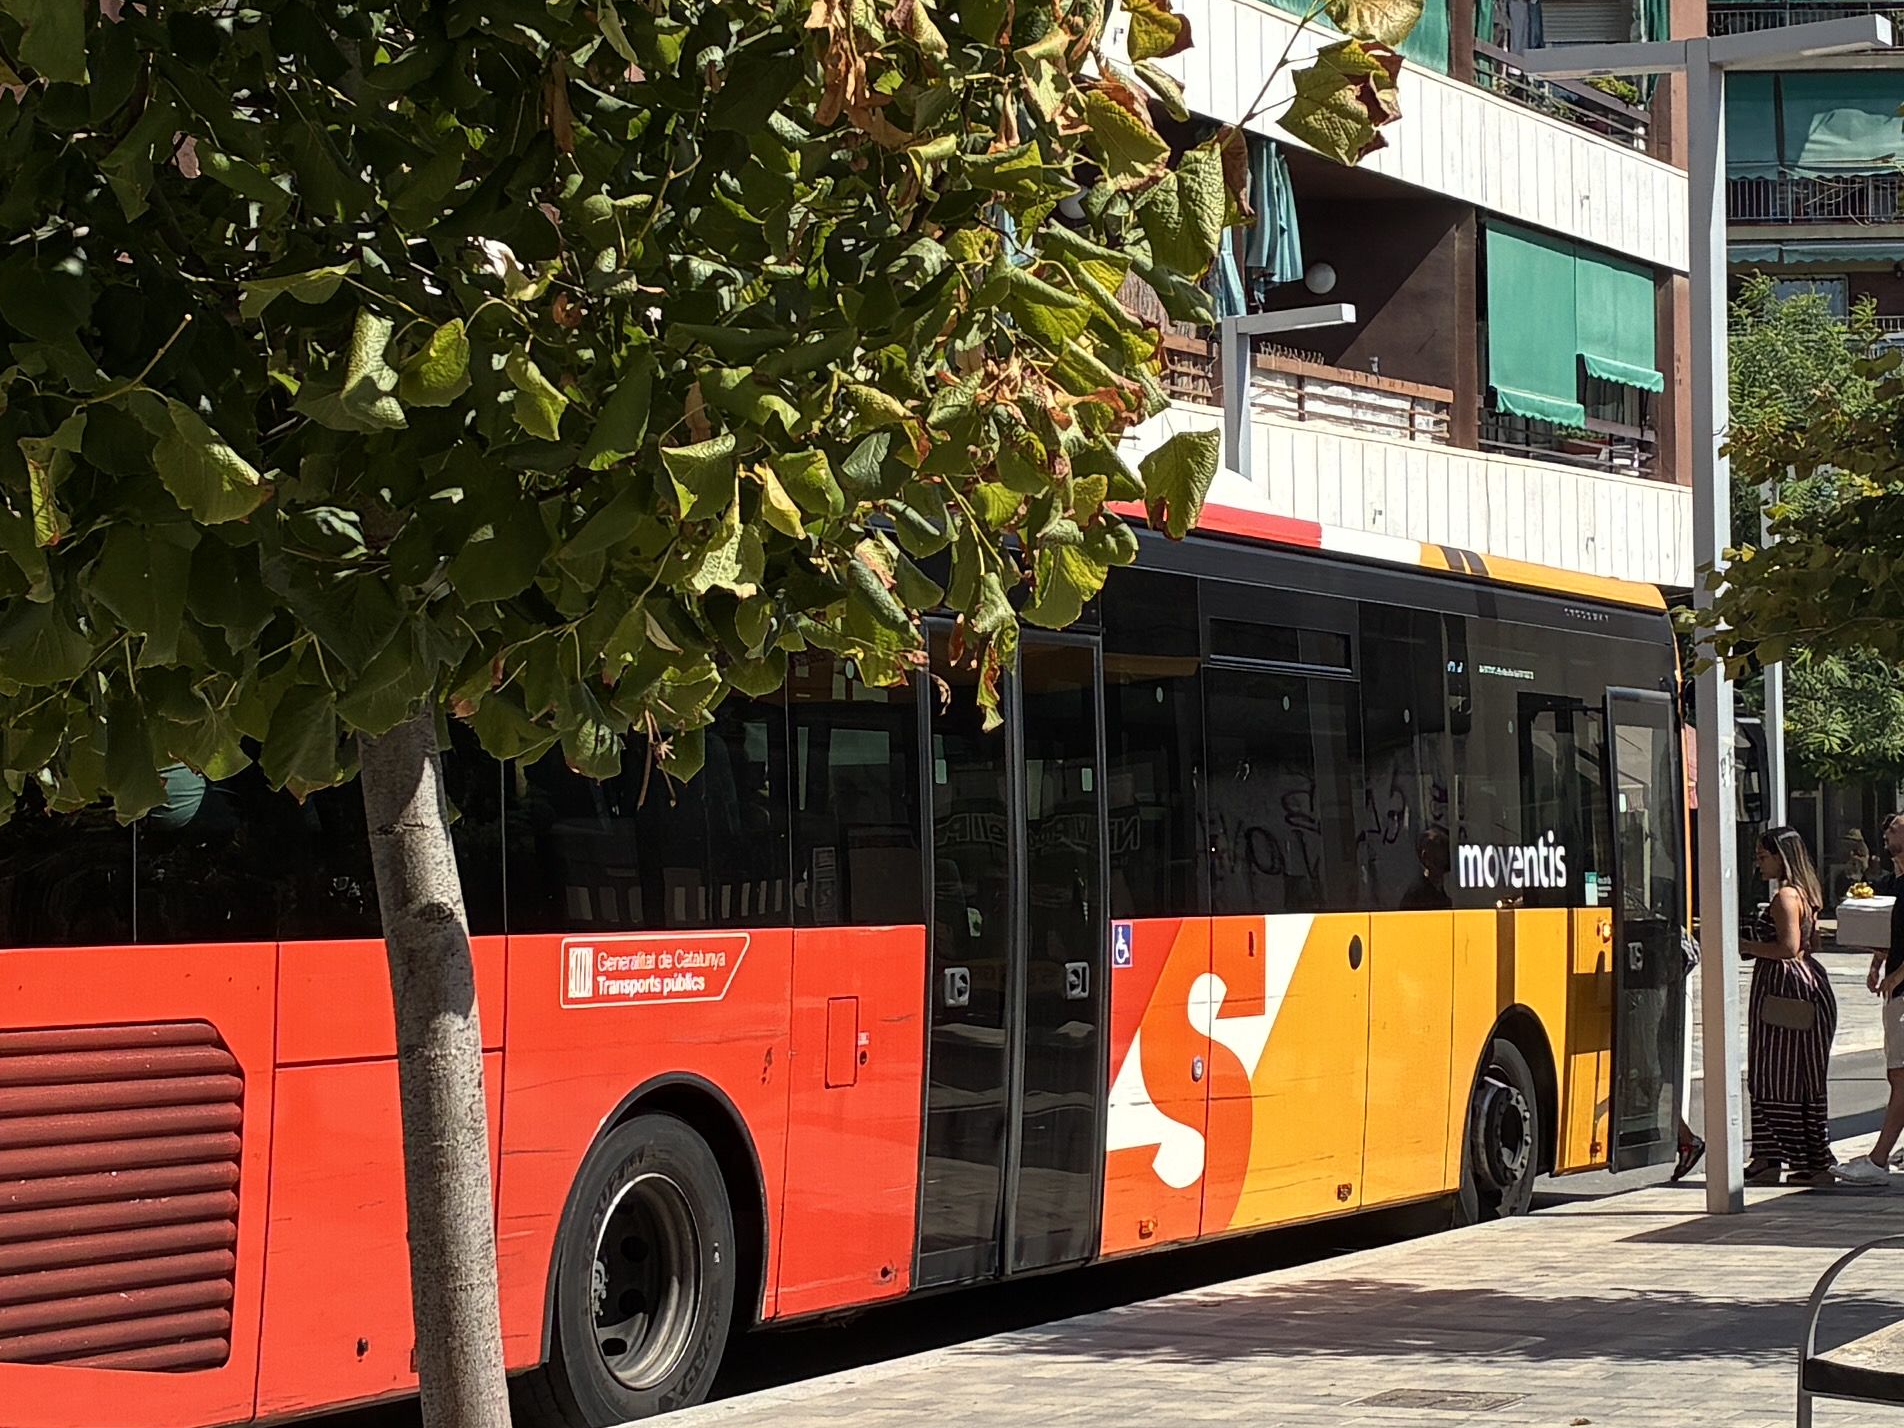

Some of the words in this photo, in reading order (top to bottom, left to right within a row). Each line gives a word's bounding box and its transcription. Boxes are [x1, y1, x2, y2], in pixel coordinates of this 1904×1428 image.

[1458, 830, 1567, 889] moventis
[597, 951, 656, 973] Generalitat
[658, 951, 673, 970] de
[674, 948, 726, 971] Catalunya
[597, 974, 662, 998] Transports
[663, 972, 706, 996] públics
